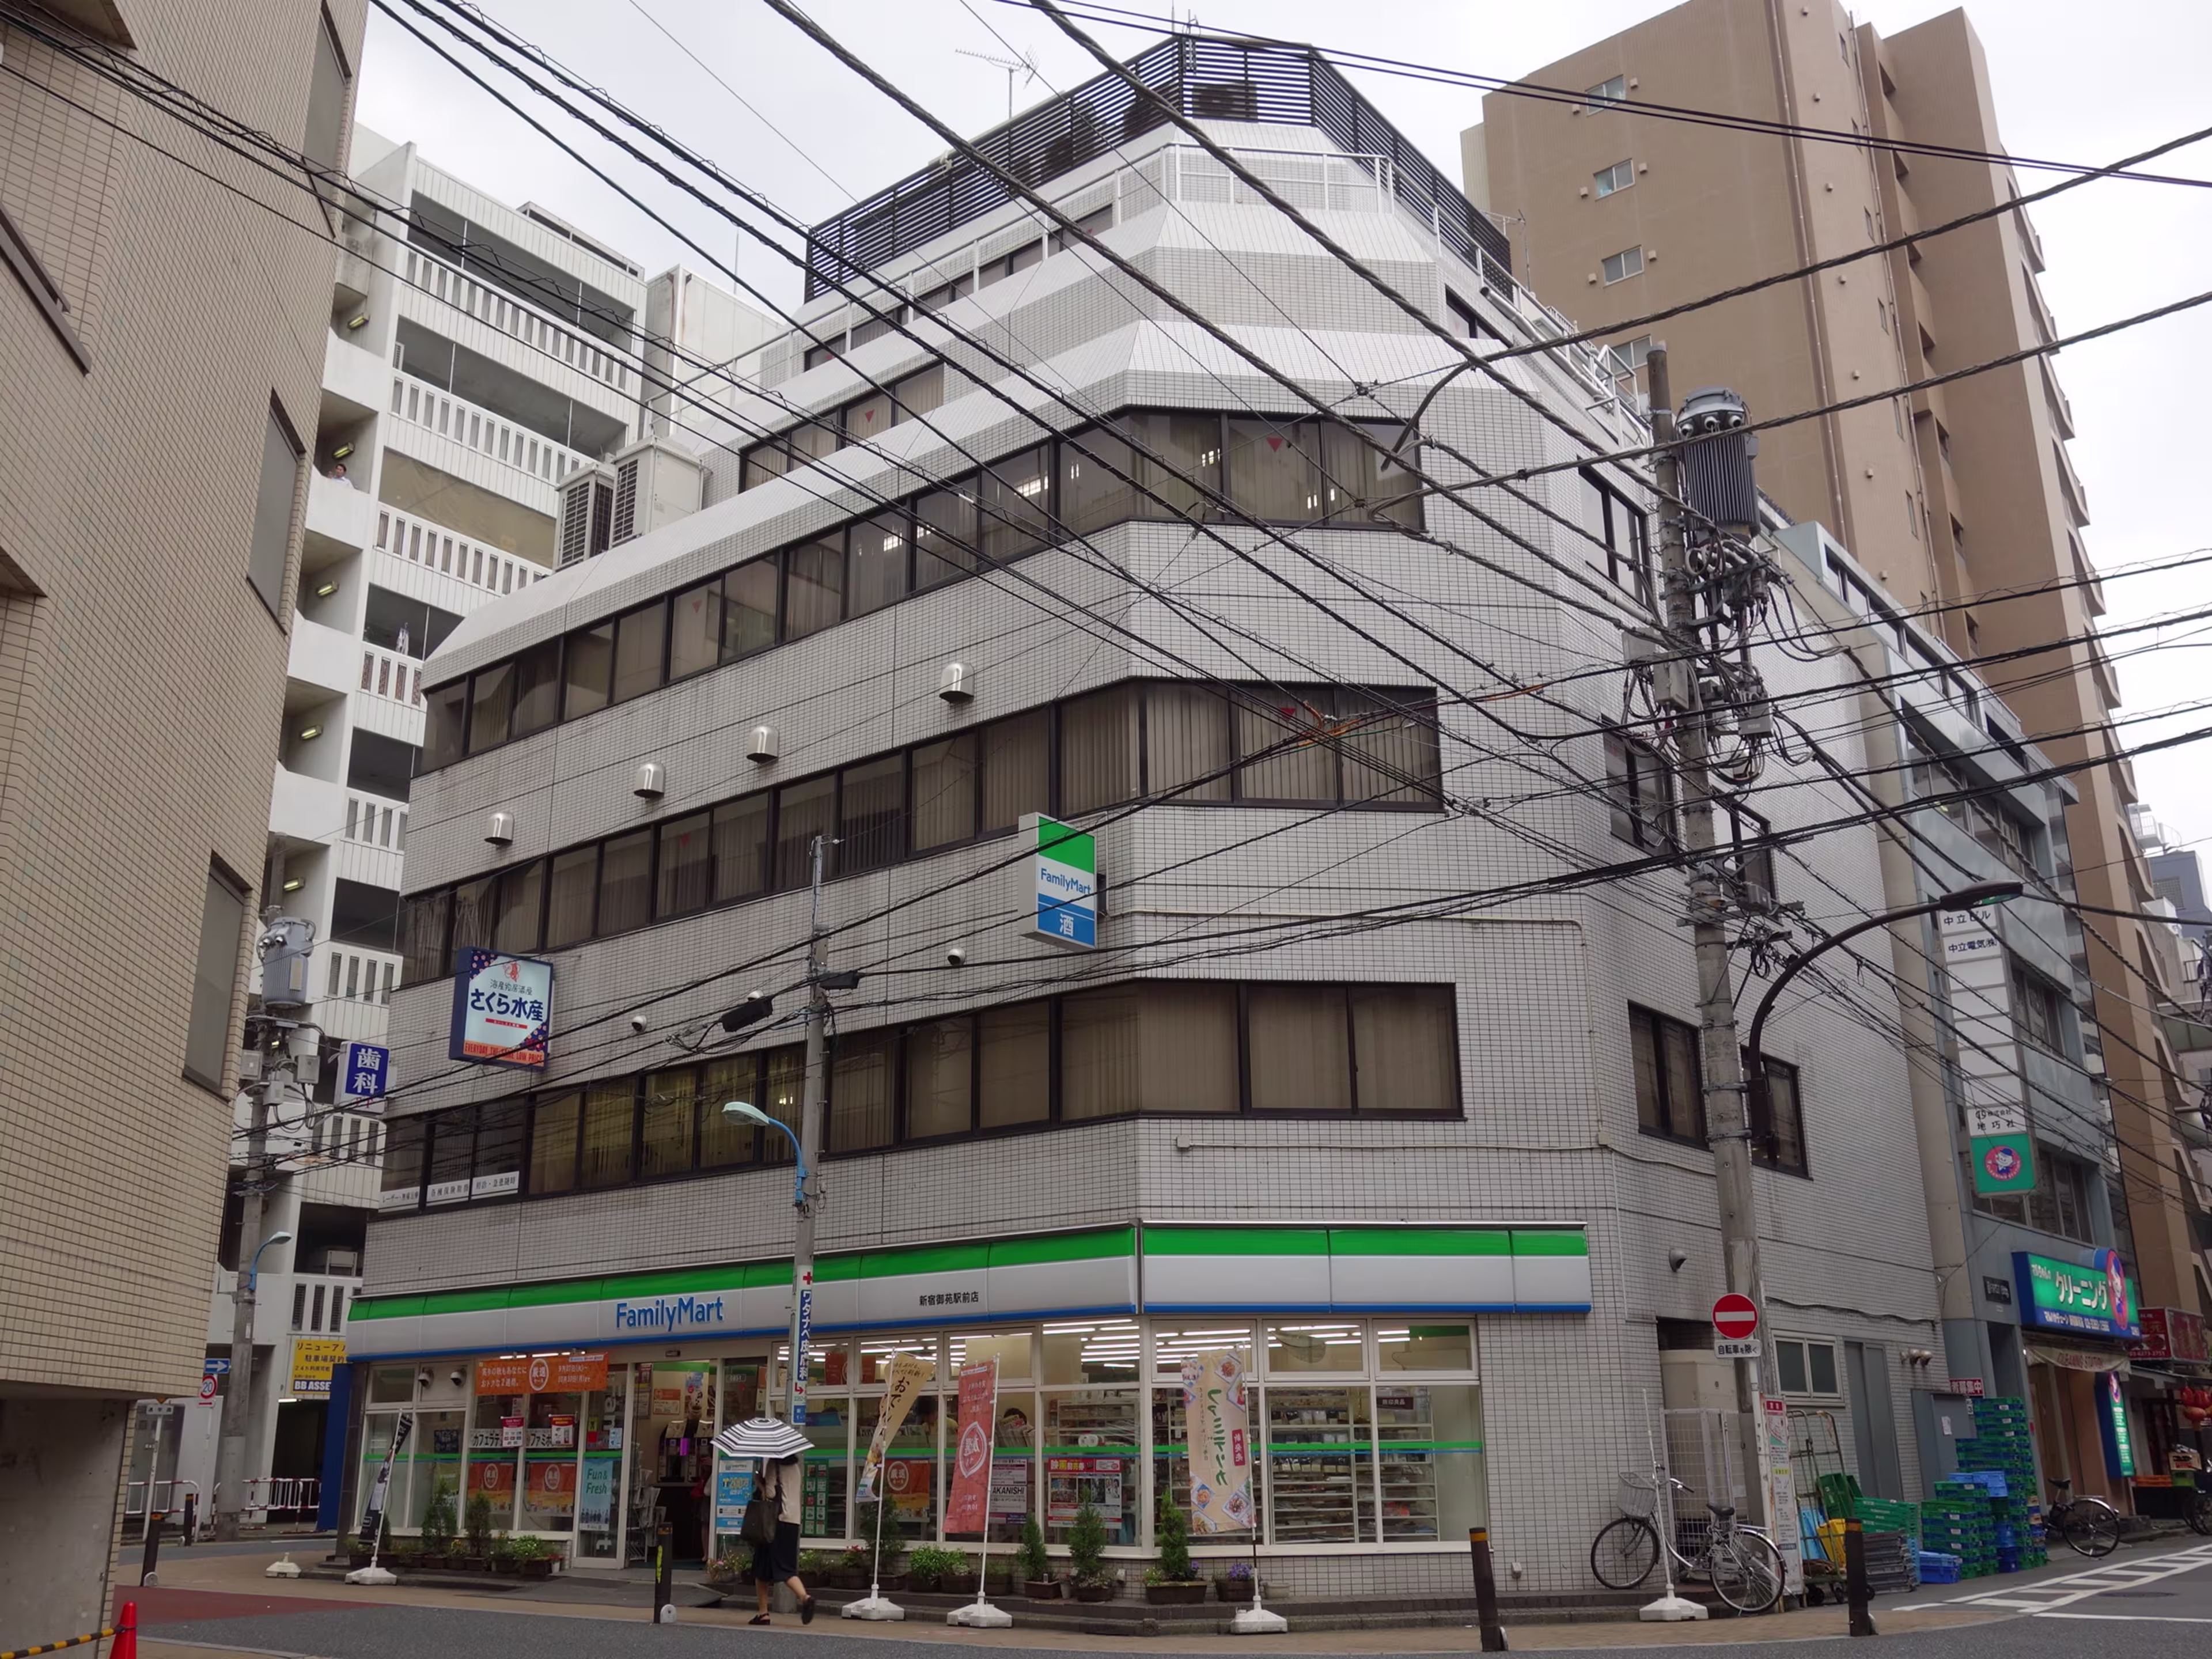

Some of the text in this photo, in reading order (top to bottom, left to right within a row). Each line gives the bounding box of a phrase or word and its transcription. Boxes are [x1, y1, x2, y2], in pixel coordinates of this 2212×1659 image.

[1041, 868, 1091, 895] FamilyMart
[1059, 913, 1074, 937] 酒
[471, 988, 543, 1021] さくら水産
[465, 1043, 487, 1054] EVERYDAY
[528, 1052, 542, 1063] PRICE
[353, 1048, 381, 1094] 歯科
[919, 1291, 979, 1306] 新宿御苑駅前店
[2056, 1271, 2107, 1310] クリーニング
[616, 1296, 724, 1332] FamilyMart
[1718, 1344, 1758, 1355] 自転車を除く
[203, 1381, 213, 1392] 20
[294, 1381, 332, 1391] BB ASSE
[586, 1482, 607, 1494] Fresh
[992, 1486, 1025, 1495] AKANISHI
